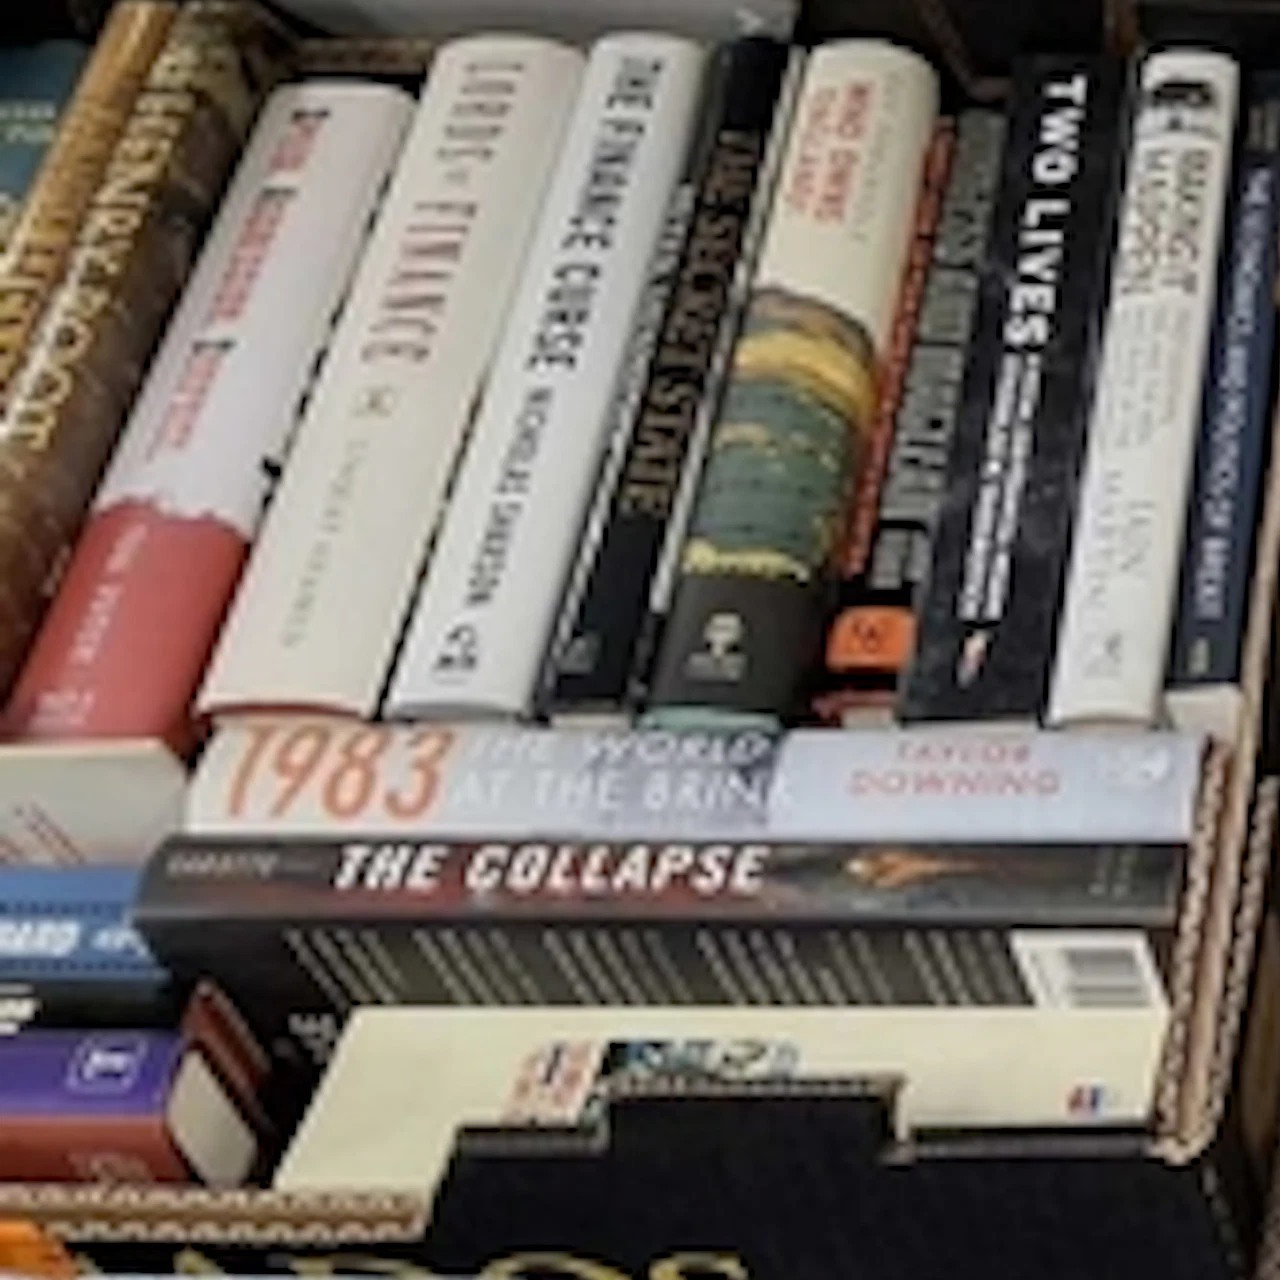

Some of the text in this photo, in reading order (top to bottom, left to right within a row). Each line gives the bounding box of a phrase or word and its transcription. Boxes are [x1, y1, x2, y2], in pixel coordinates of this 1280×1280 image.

[606, 58, 664, 111] THE
[1031, 75, 1088, 184] TWO
[559, 122, 644, 249] FINANCE
[362, 201, 478, 363] FINANCE
[531, 261, 600, 369] CURSE
[1004, 200, 1066, 352] LIVES
[228, 725, 454, 819] 1983
[534, 770, 629, 807] THE
[585, 732, 769, 764] WORLD
[848, 769, 1062, 796] DOWNING
[336, 845, 769, 890] THE COLLAPSE
